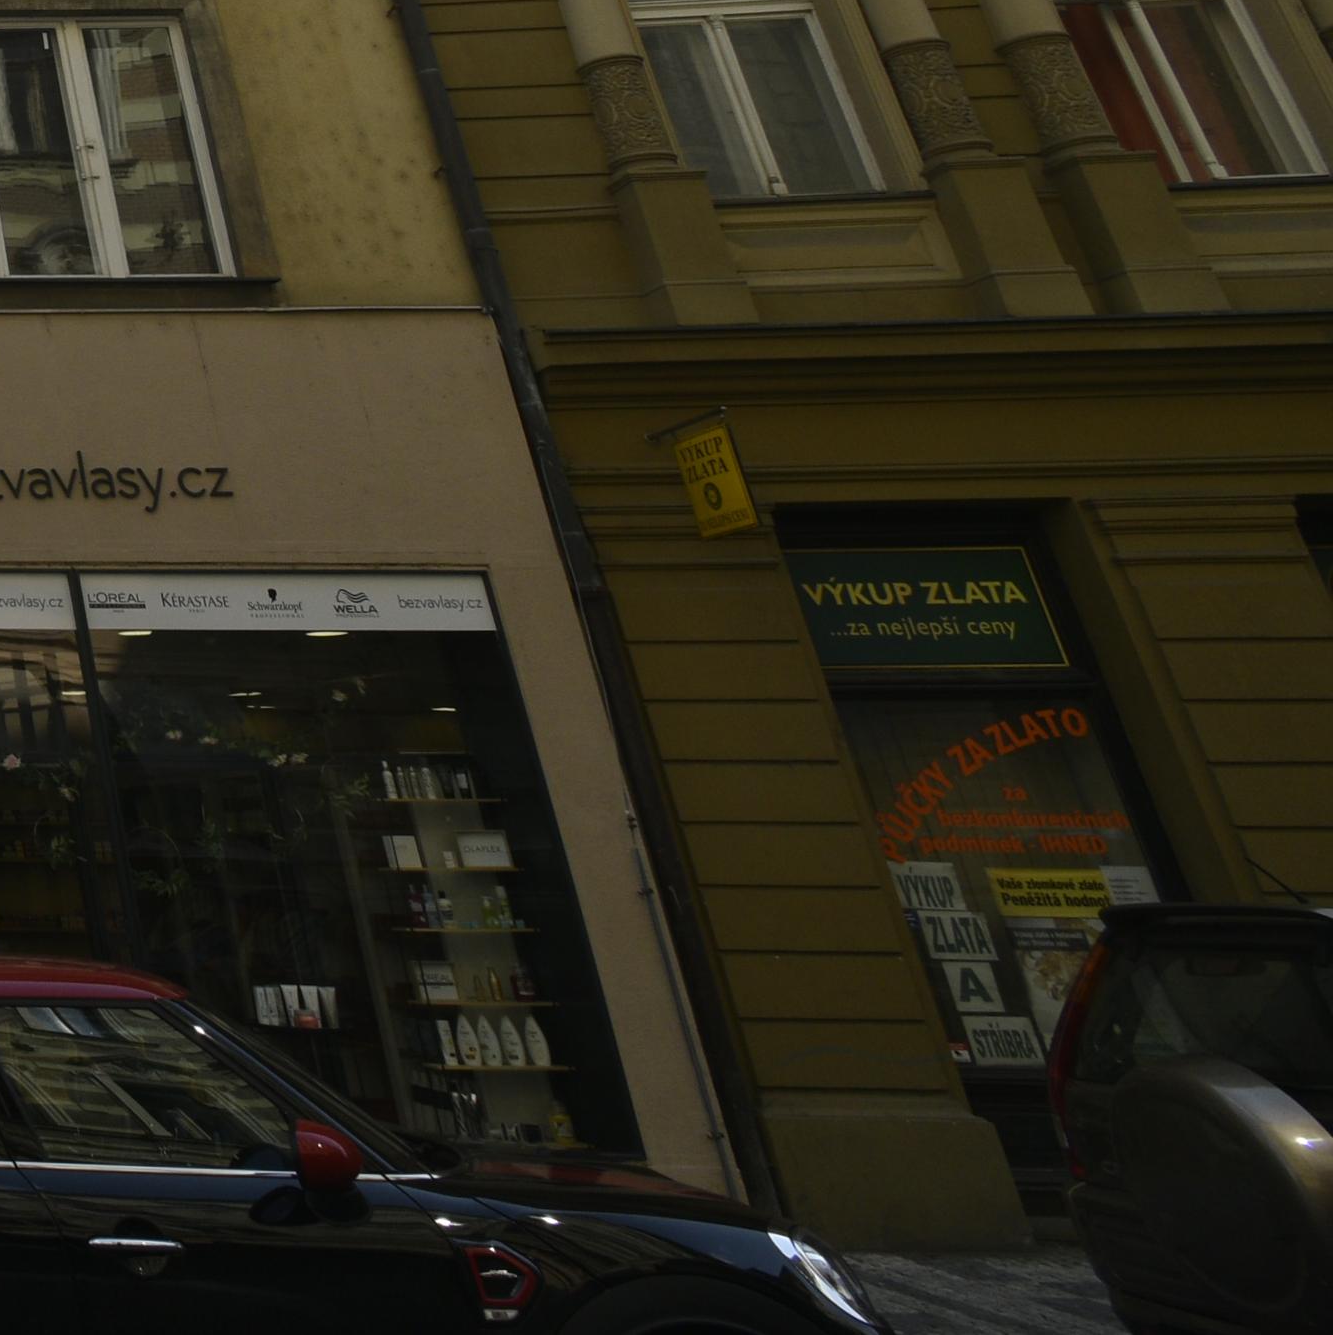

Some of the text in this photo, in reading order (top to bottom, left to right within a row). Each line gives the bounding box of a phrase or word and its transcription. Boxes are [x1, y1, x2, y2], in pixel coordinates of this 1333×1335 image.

[686, 457, 730, 485] ZLATA
[160, 592, 230, 608] KÉRASTASE
[247, 601, 303, 613] Schwarzkopf
[333, 604, 379, 614] WELLA
[397, 594, 484, 612] bezvavlasy.cz
[801, 576, 1030, 606] VÝKUP ZLATA
[877, 616, 961, 641] nejlepší
[967, 619, 1017, 641] ceny
[946, 736, 997, 777] ZA
[982, 706, 1090, 756] ZLATO
[896, 866, 955, 908] VÝKUP
[996, 877, 1023, 890] Vaše
[1000, 892, 1062, 907] Peněžitá
[926, 916, 993, 954] ZLATA
[960, 967, 994, 1003] A
[971, 1022, 1039, 1059] STŘÍBRA
